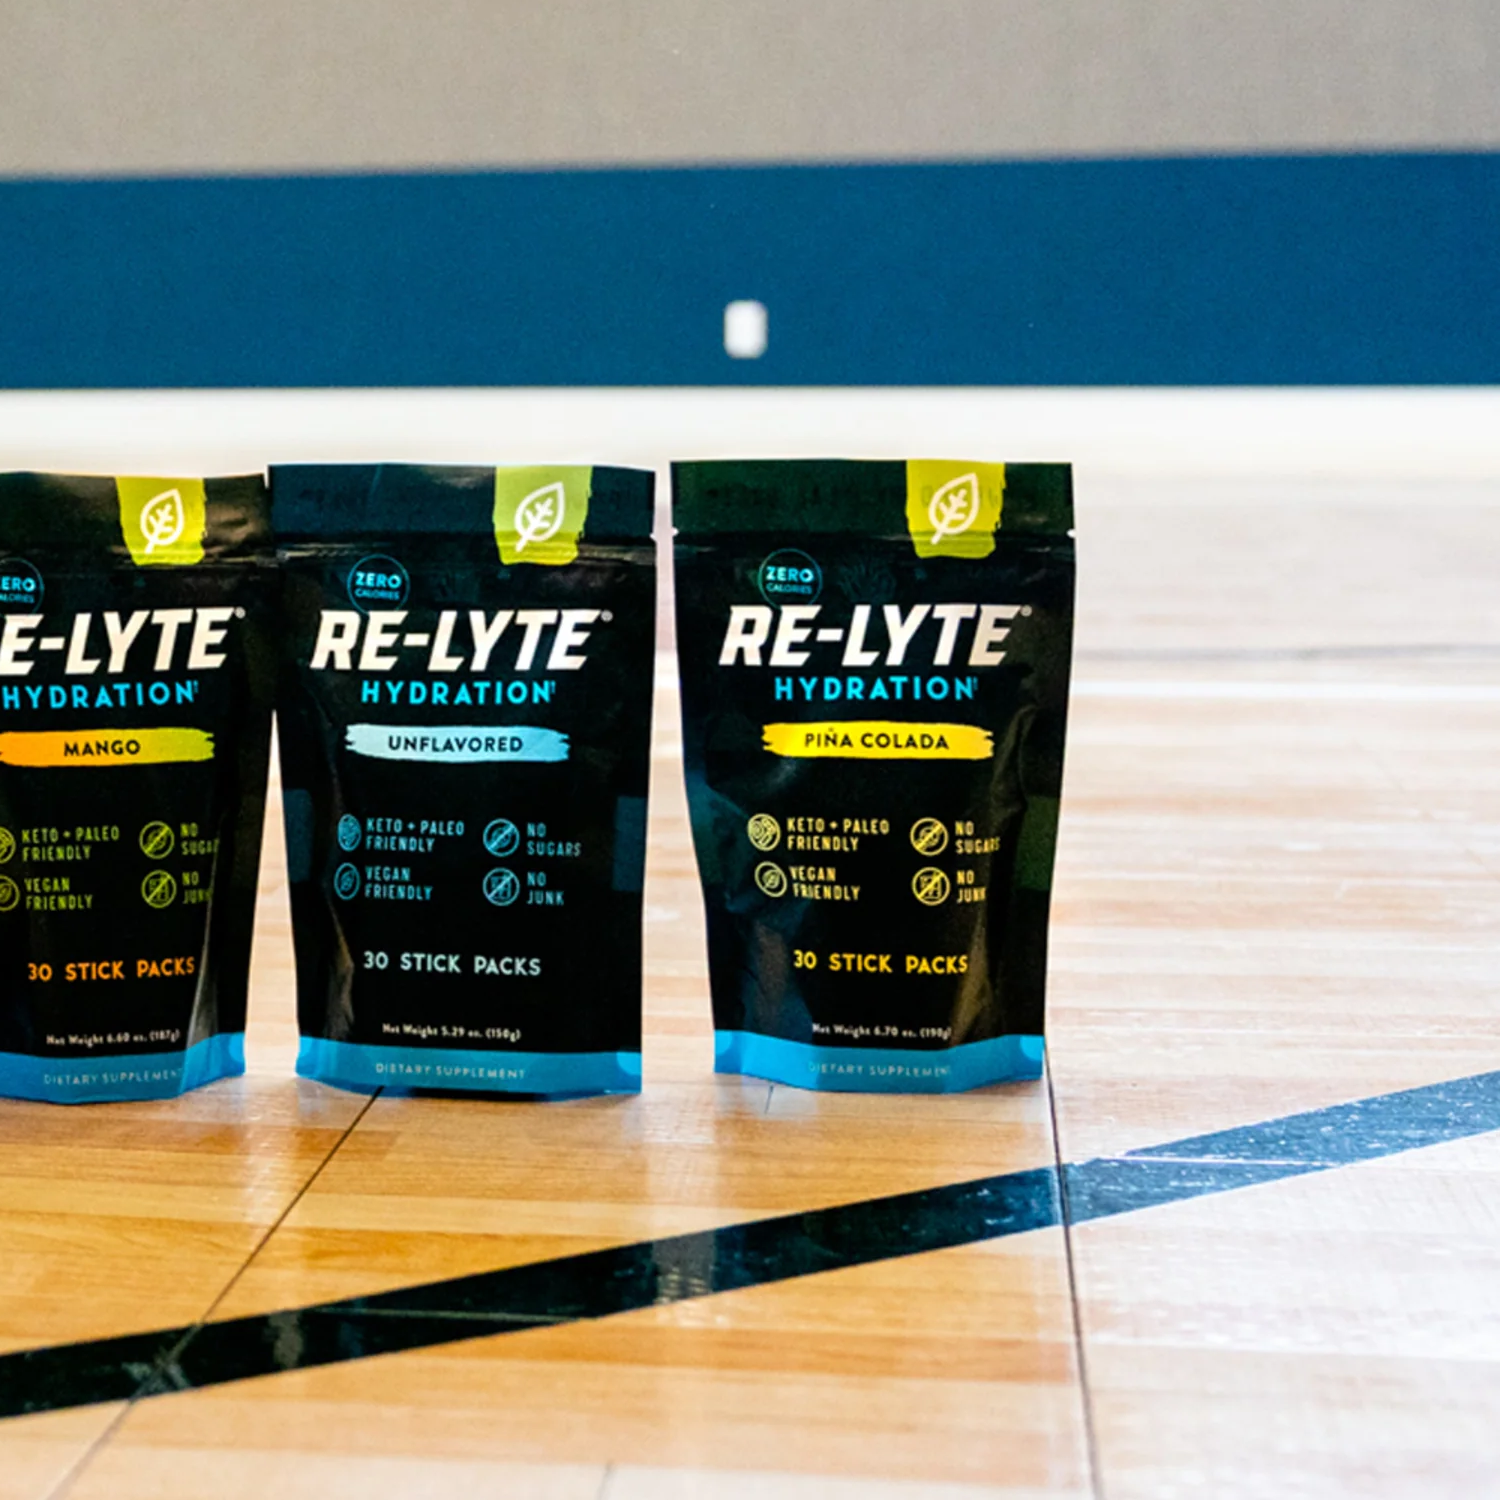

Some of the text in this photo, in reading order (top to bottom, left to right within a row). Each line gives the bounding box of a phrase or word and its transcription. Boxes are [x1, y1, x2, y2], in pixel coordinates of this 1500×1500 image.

[355, 572, 401, 587] ZERO
[766, 566, 814, 583] ZERO
[388, 736, 523, 752] UNFLAVORED
[804, 727, 949, 750] PIÑA COLADA
[64, 740, 140, 756] MANGO
[180, 822, 198, 837] NO
[366, 818, 402, 833] KETO
[420, 820, 464, 835] PALEO
[527, 823, 546, 837] NO
[787, 818, 824, 833] KETO
[843, 819, 889, 834] PALEO
[955, 821, 974, 836] NO
[22, 828, 58, 843] KETO
[76, 826, 119, 842] PALEO
[366, 836, 435, 852] FRIENDLY
[527, 841, 581, 857] SUGARS
[788, 836, 858, 851] FRIENDLY
[23, 845, 92, 861] FRIENDLY
[182, 871, 199, 885] NO
[365, 866, 410, 881] VEGAN
[527, 872, 546, 886] NO
[789, 866, 836, 881] VEGAN
[957, 870, 974, 884] NO
[24, 878, 69, 892] VEGAN
[364, 884, 433, 900] FRIENDLY
[792, 884, 860, 900] FRIENDLY
[26, 895, 92, 911] FRIENDLY
[527, 891, 564, 905] JUNK
[28, 957, 195, 980] 30 STICK PACKS
[364, 951, 541, 975] 30 STICK PACKS
[793, 951, 968, 973] 30 STICK PACKS
[382, 1023, 399, 1034] Net
[402, 1024, 437, 1039] Weight
[441, 1026, 465, 1037] 5.29
[486, 1028, 521, 1042] (150g)
[812, 1023, 829, 1034] Net
[832, 1024, 870, 1039] Weight
[874, 1026, 898, 1037] 6.70
[46, 1035, 64, 1045] Net
[68, 1034, 104, 1048] Weight
[376, 1063, 525, 1078] DIETARY SUPPLEMENT
[809, 1063, 863, 1074] DIETARY
[44, 1074, 98, 1085] DIETARY
